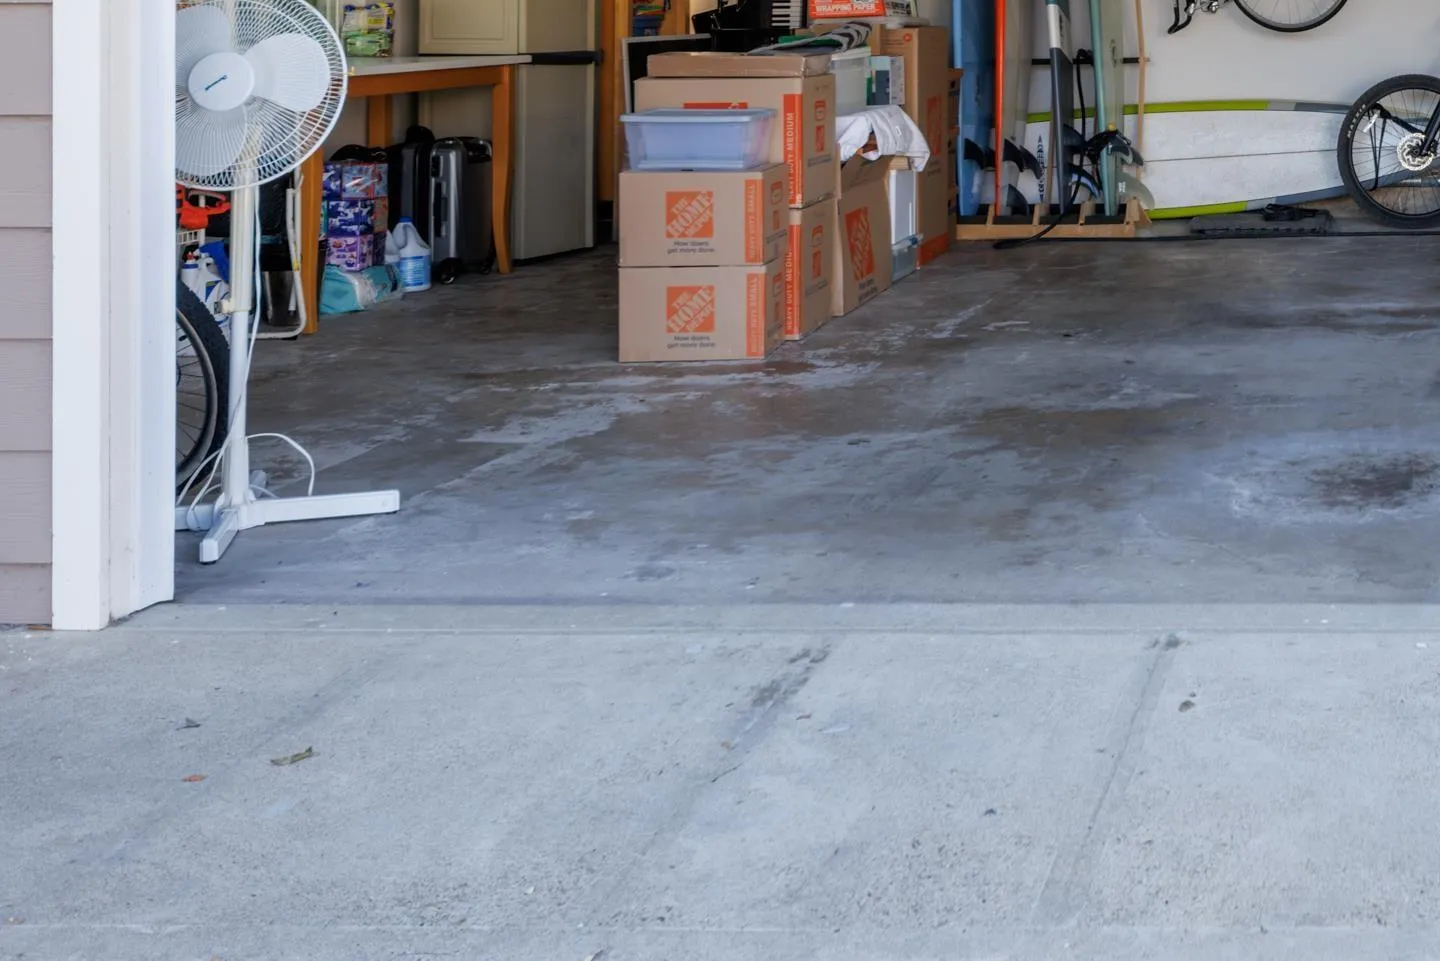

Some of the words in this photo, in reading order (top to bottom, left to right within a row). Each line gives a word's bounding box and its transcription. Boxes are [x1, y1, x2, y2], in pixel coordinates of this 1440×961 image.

[786, 112, 794, 151] MEDIUM
[667, 191, 713, 237] HOME
[667, 286, 714, 332] HOME
